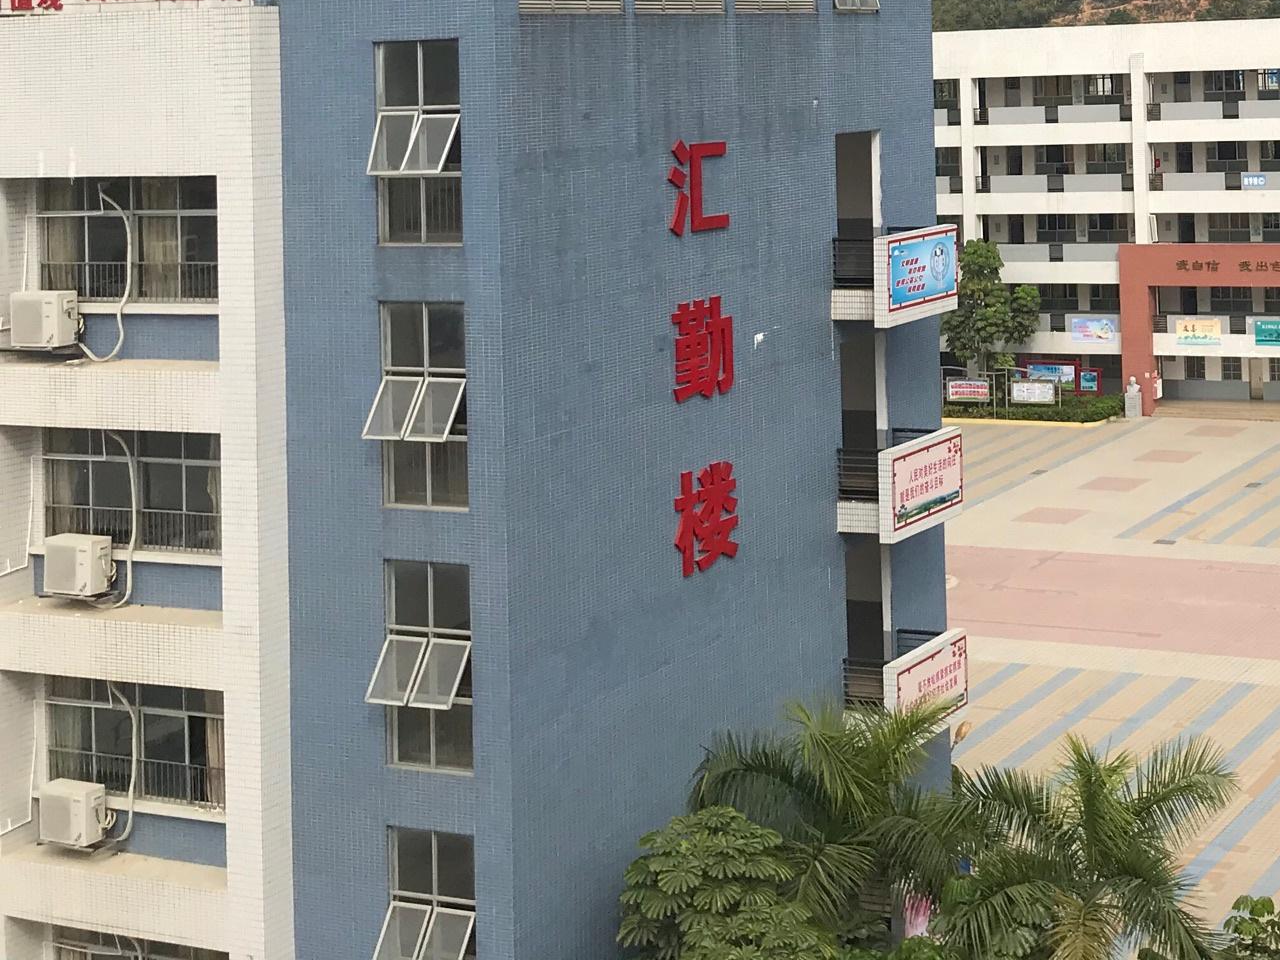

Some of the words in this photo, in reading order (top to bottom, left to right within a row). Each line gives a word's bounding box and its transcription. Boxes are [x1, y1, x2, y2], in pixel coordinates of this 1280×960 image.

[668, 139, 740, 577] 汇勤楼
[1175, 259, 1221, 272] 我自信
